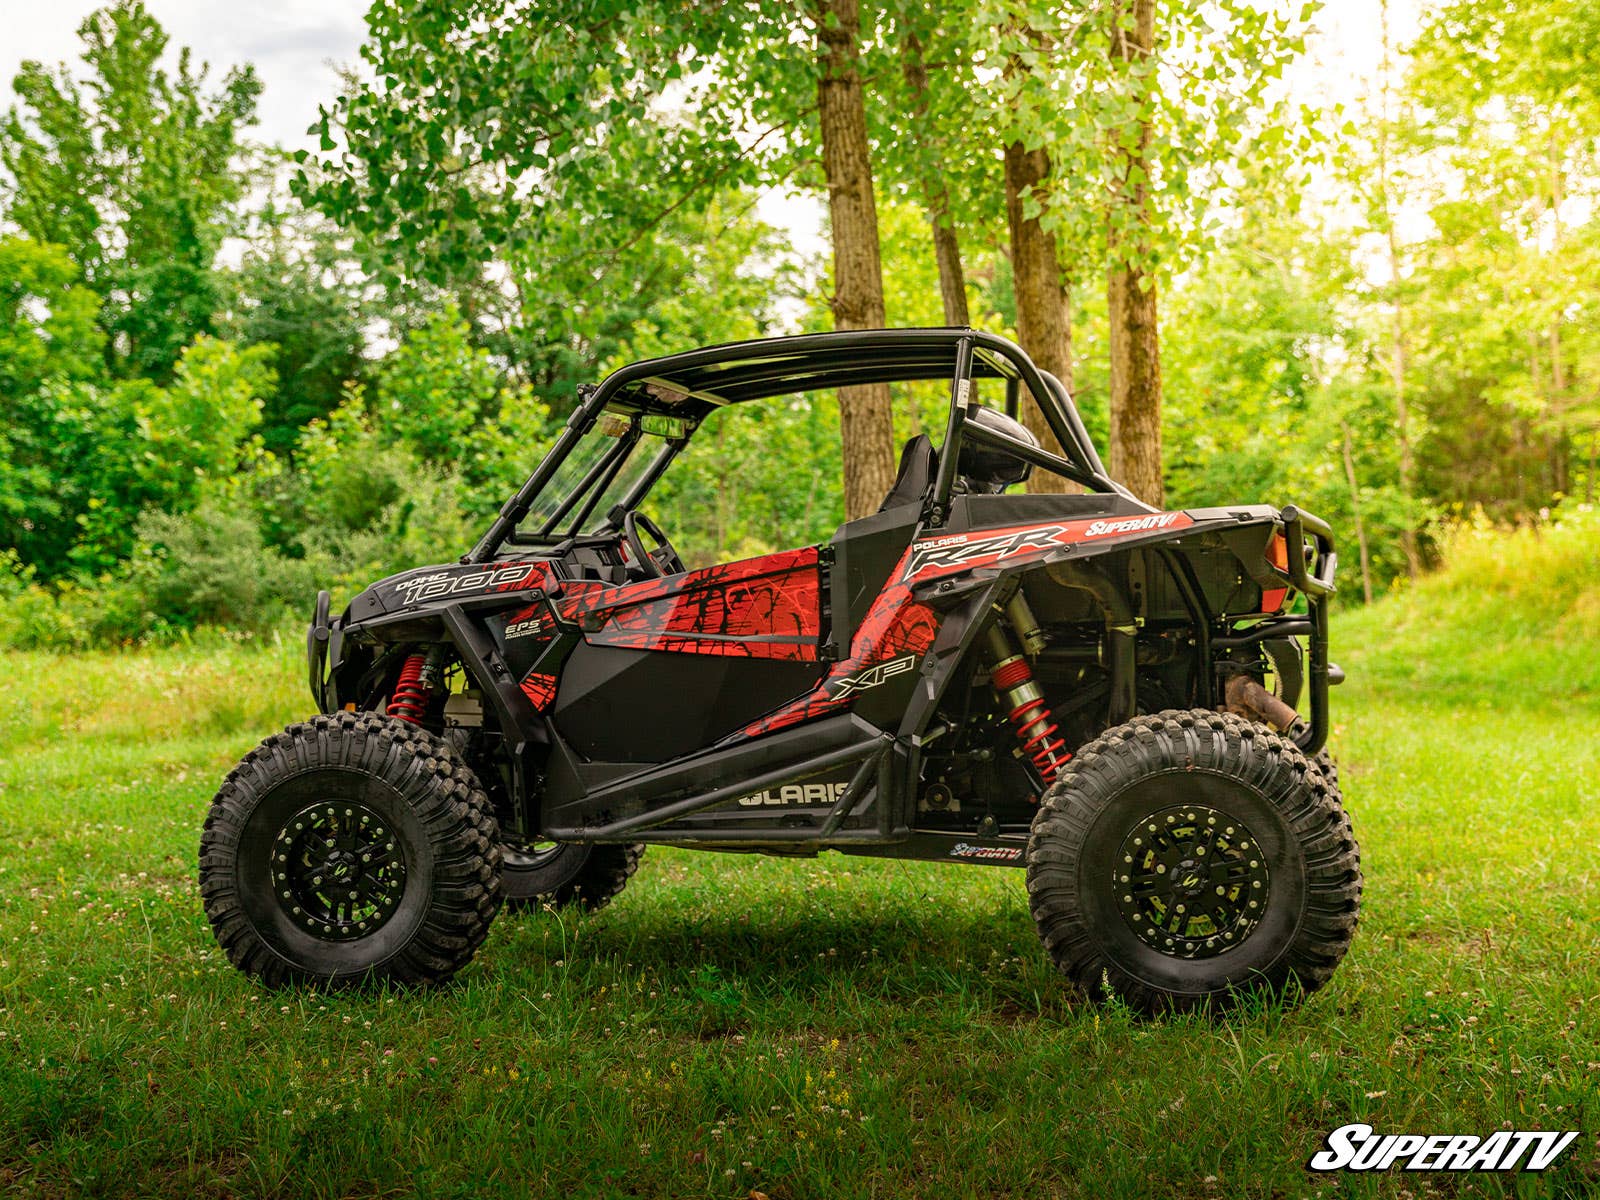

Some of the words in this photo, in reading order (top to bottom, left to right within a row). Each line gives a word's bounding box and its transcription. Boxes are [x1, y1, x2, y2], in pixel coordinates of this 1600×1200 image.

[902, 525, 1068, 582] RZR
[913, 535, 968, 552] POLARIS
[395, 572, 449, 591] DOHC
[402, 564, 533, 605] 1000
[505, 619, 541, 634] EPS
[829, 655, 915, 702] XP
